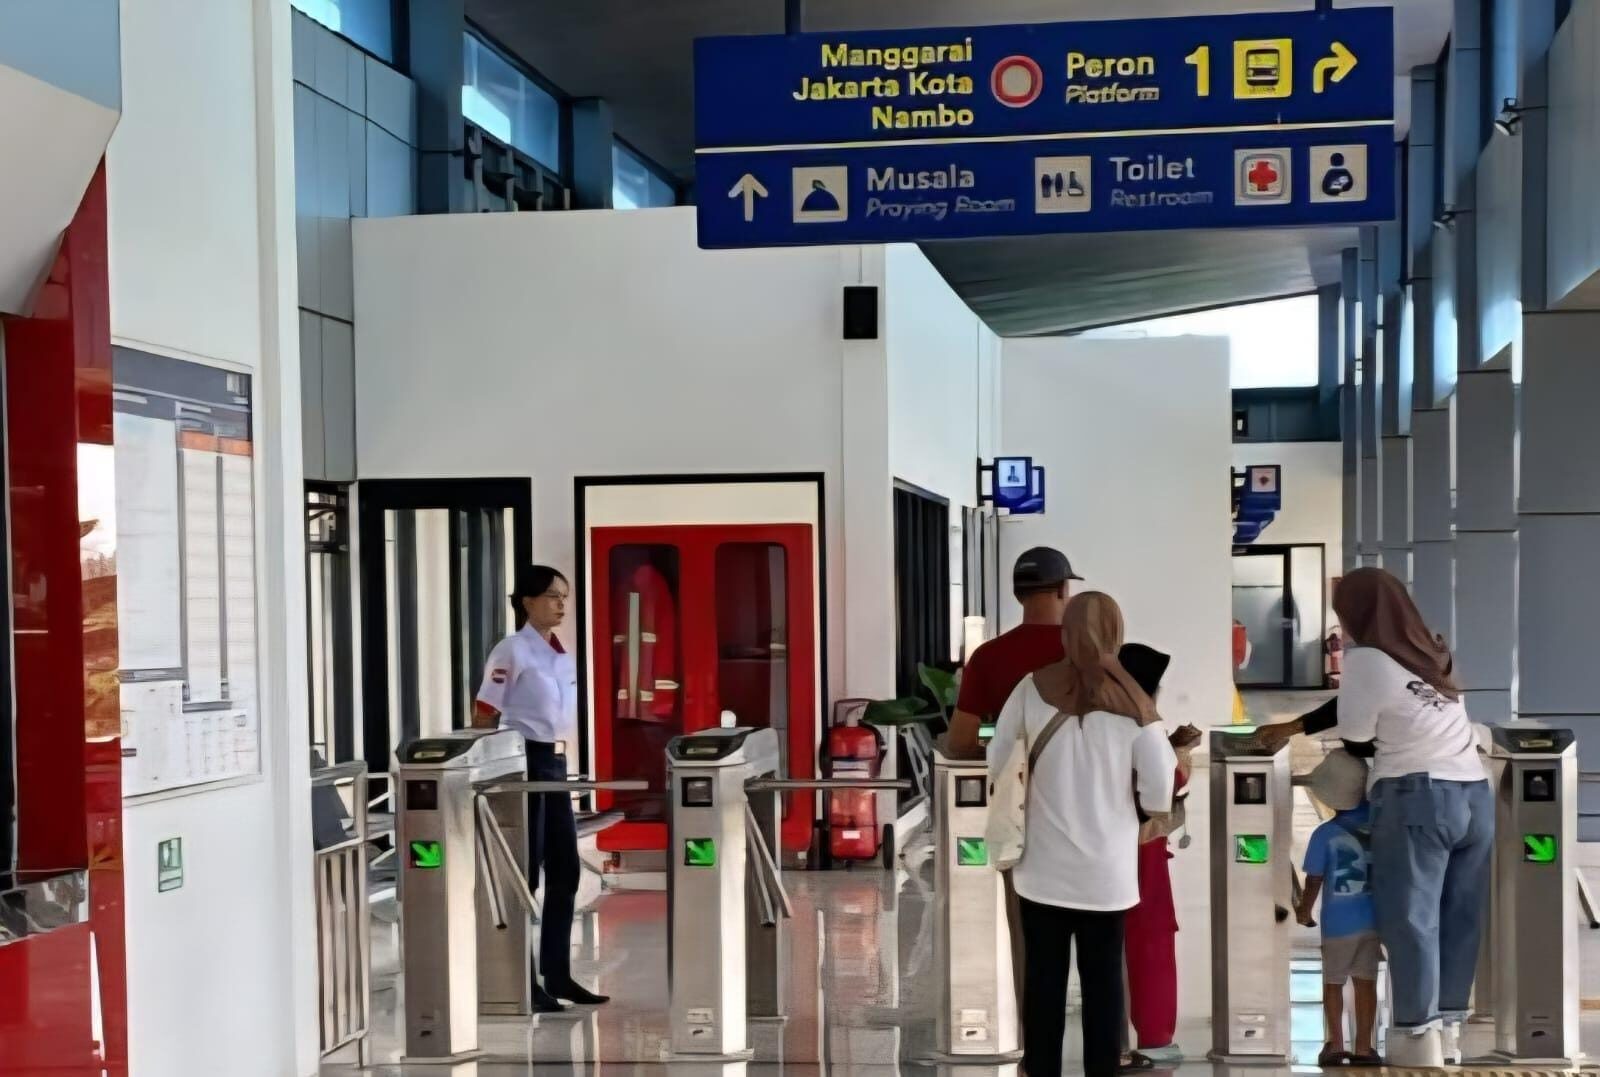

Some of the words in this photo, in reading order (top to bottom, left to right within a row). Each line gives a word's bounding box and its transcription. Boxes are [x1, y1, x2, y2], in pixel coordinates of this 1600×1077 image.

[821, 37, 973, 70] Manggarai
[1066, 53, 1155, 79] Peron
[1184, 46, 1210, 97] 1
[792, 76, 899, 101] Jakarta
[909, 71, 974, 96] Kota
[1066, 82, 1159, 105] Platform
[872, 103, 974, 130] Nambo
[867, 163, 975, 191] Musala
[1108, 154, 1196, 182] Toilet
